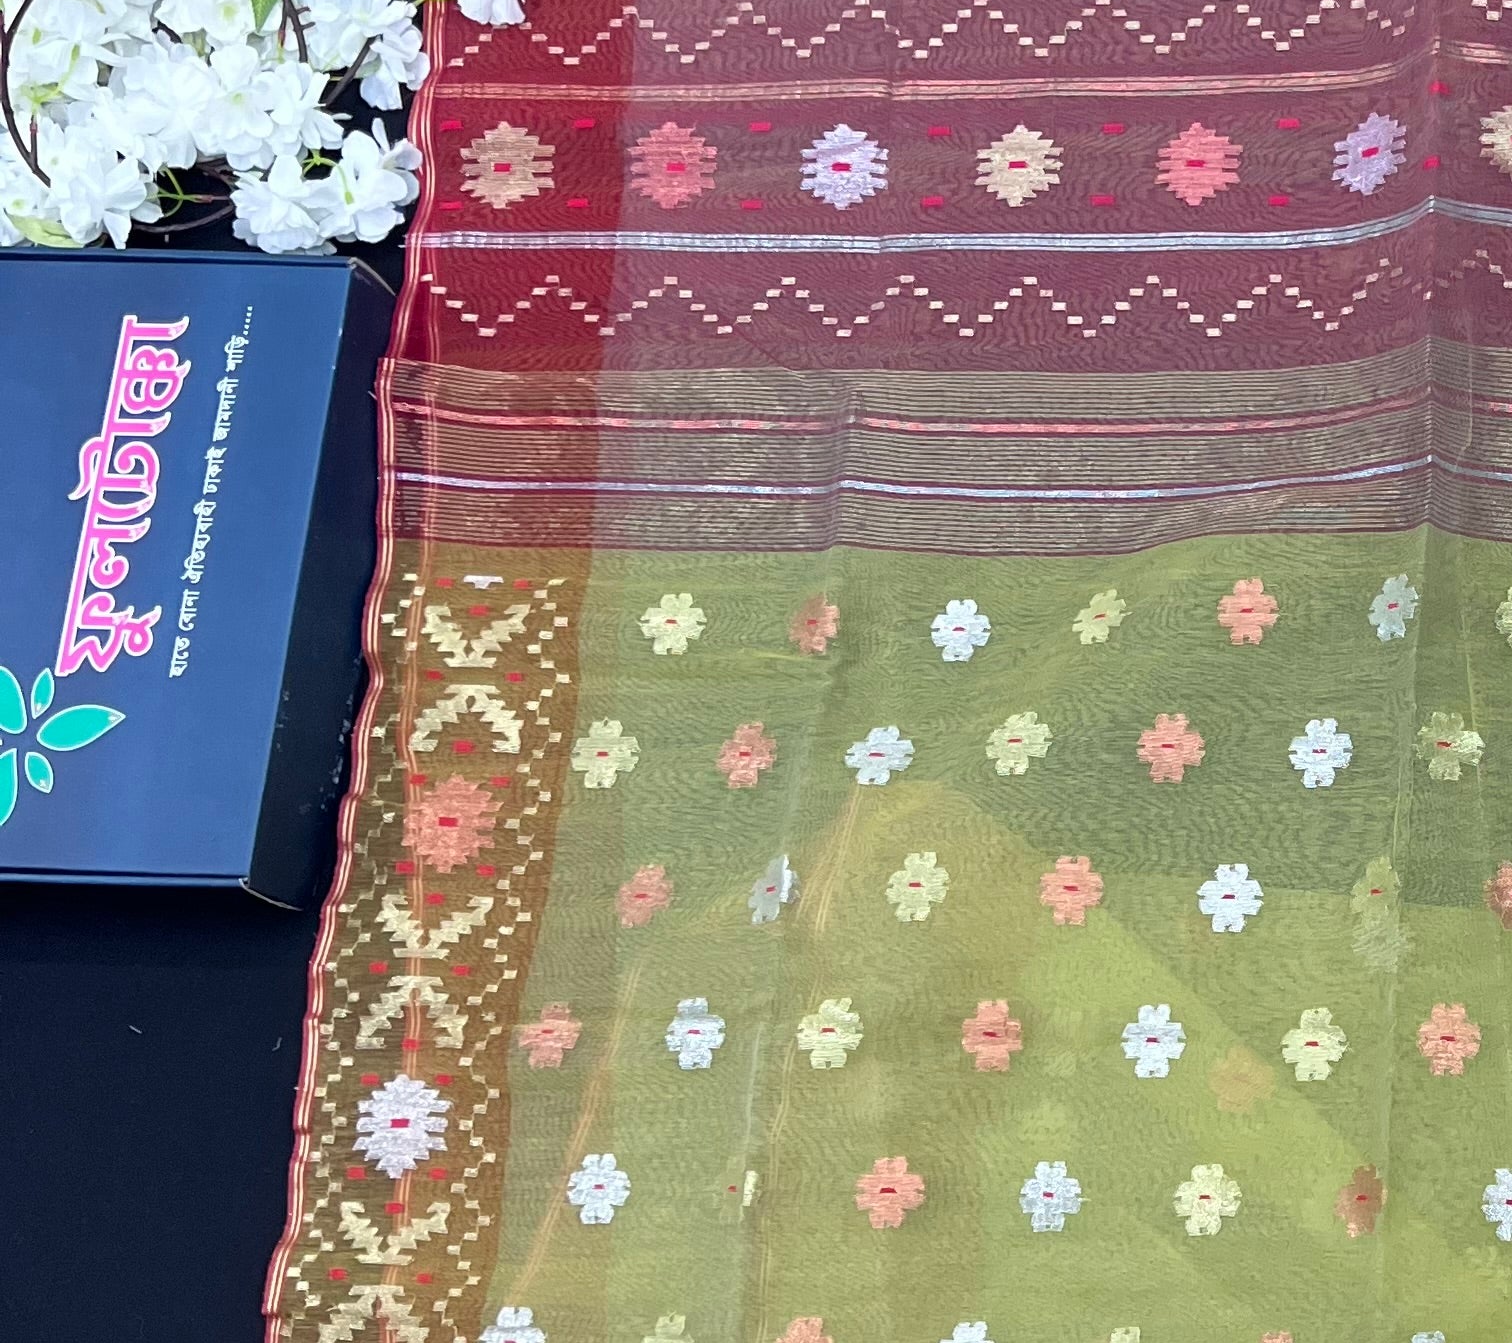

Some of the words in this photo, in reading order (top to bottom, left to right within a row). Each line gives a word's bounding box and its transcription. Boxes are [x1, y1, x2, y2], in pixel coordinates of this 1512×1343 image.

[213, 376, 239, 442] জামদানী
[203, 445, 228, 496] ঢাকাই
[181, 498, 217, 584] ঐতিহ্যবাহী
[178, 588, 201, 632] বোনা
[168, 636, 191, 678] হাতে
